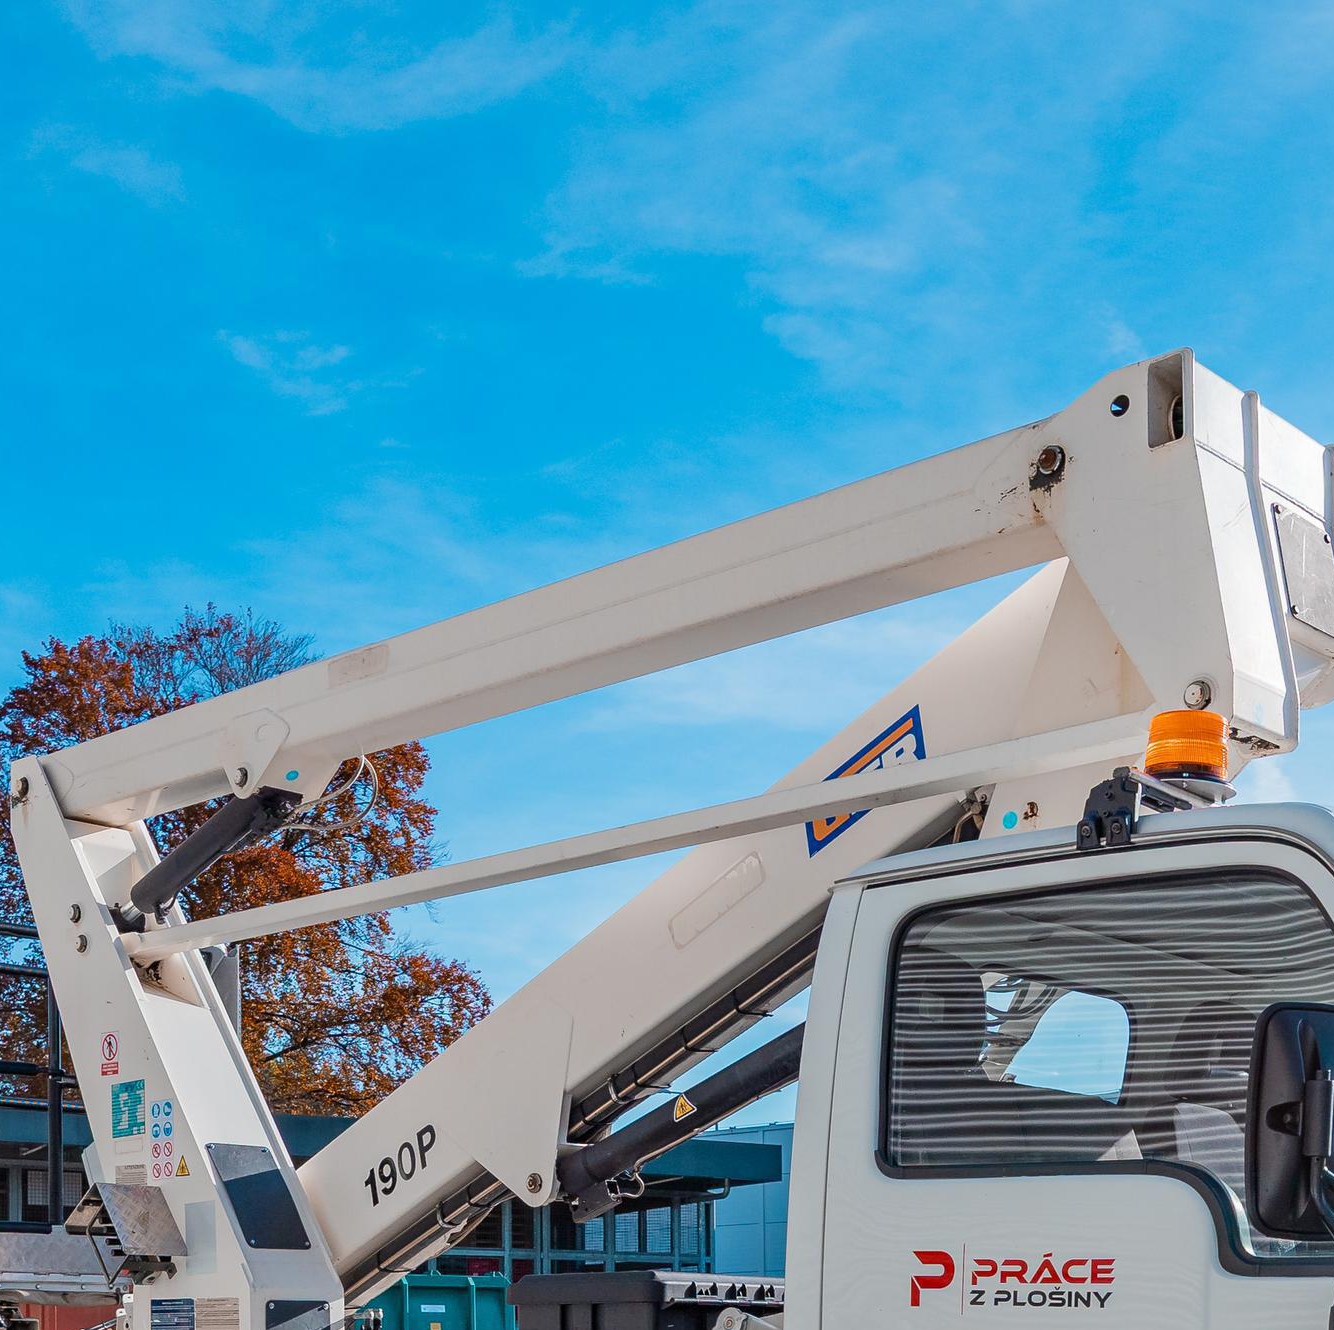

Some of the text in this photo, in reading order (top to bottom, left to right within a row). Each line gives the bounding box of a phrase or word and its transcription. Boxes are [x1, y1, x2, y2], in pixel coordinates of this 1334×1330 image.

[364, 1124, 436, 1208] 190P
[971, 1252, 1116, 1286] PRÁCE
[969, 1286, 1113, 1309] Z PLOŠINY
